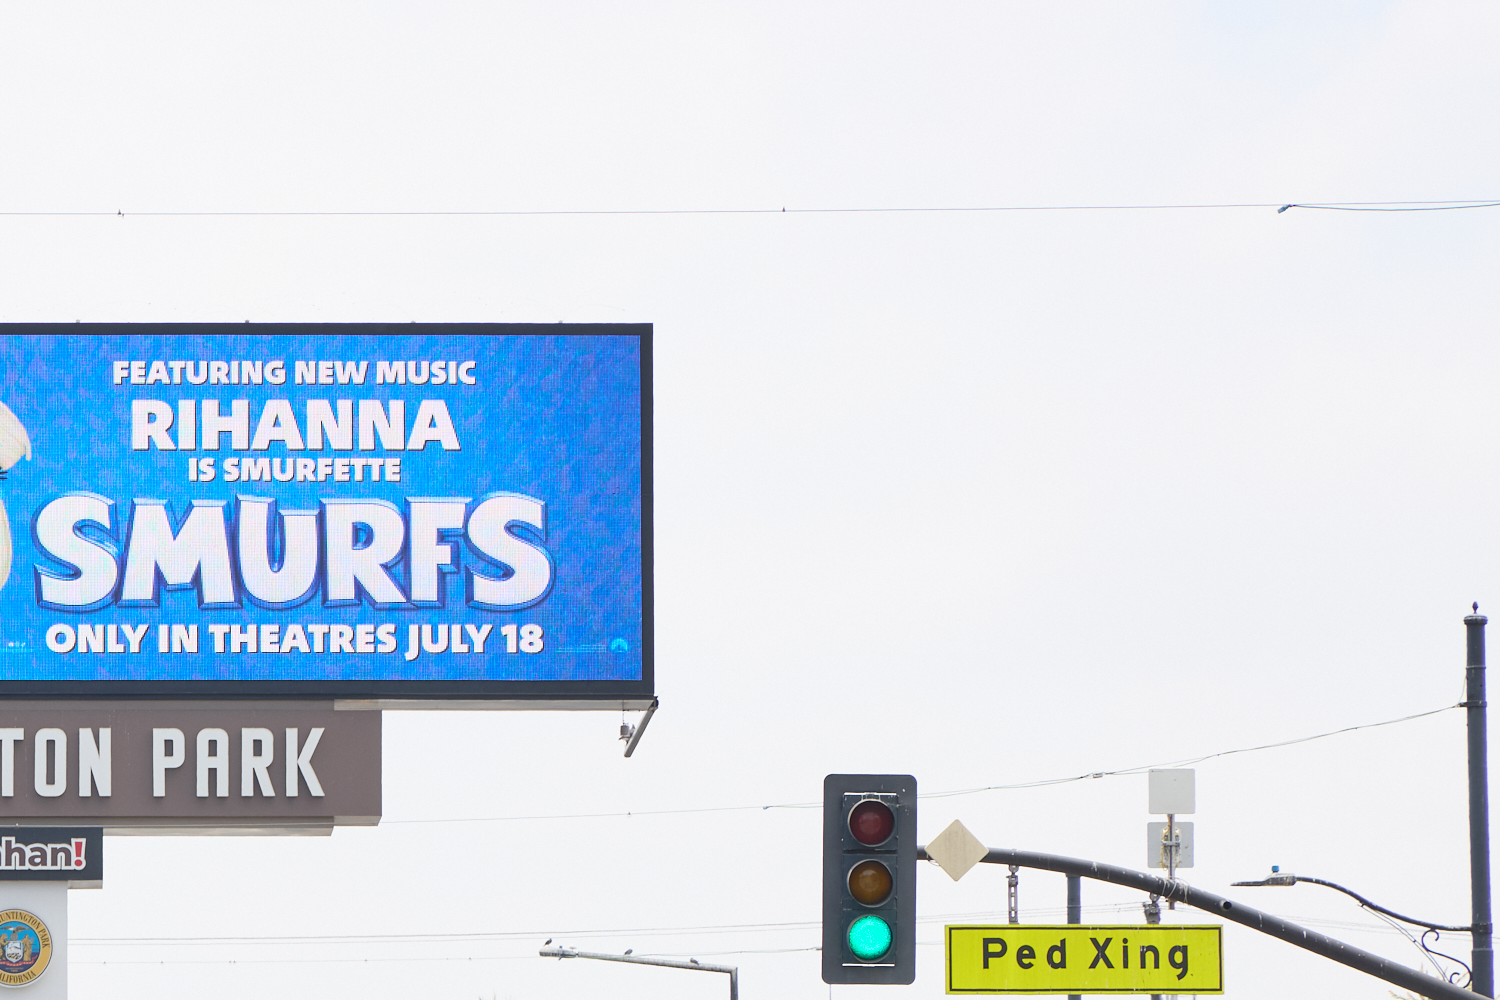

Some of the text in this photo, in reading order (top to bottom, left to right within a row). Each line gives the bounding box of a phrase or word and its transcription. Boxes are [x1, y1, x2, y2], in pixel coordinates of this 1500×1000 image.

[112, 360, 476, 386] FEATURING NEW MUSIC
[131, 398, 460, 452] RIHANNA
[188, 457, 401, 483] IS SMURFETTE
[32, 490, 556, 613] SMURFS
[45, 623, 544, 662] ONLY IN THEATRES JULY 18
[152, 727, 326, 799] PARK
[39, 929, 51, 949] PARK
[982, 936, 1190, 980] Ped Xing
